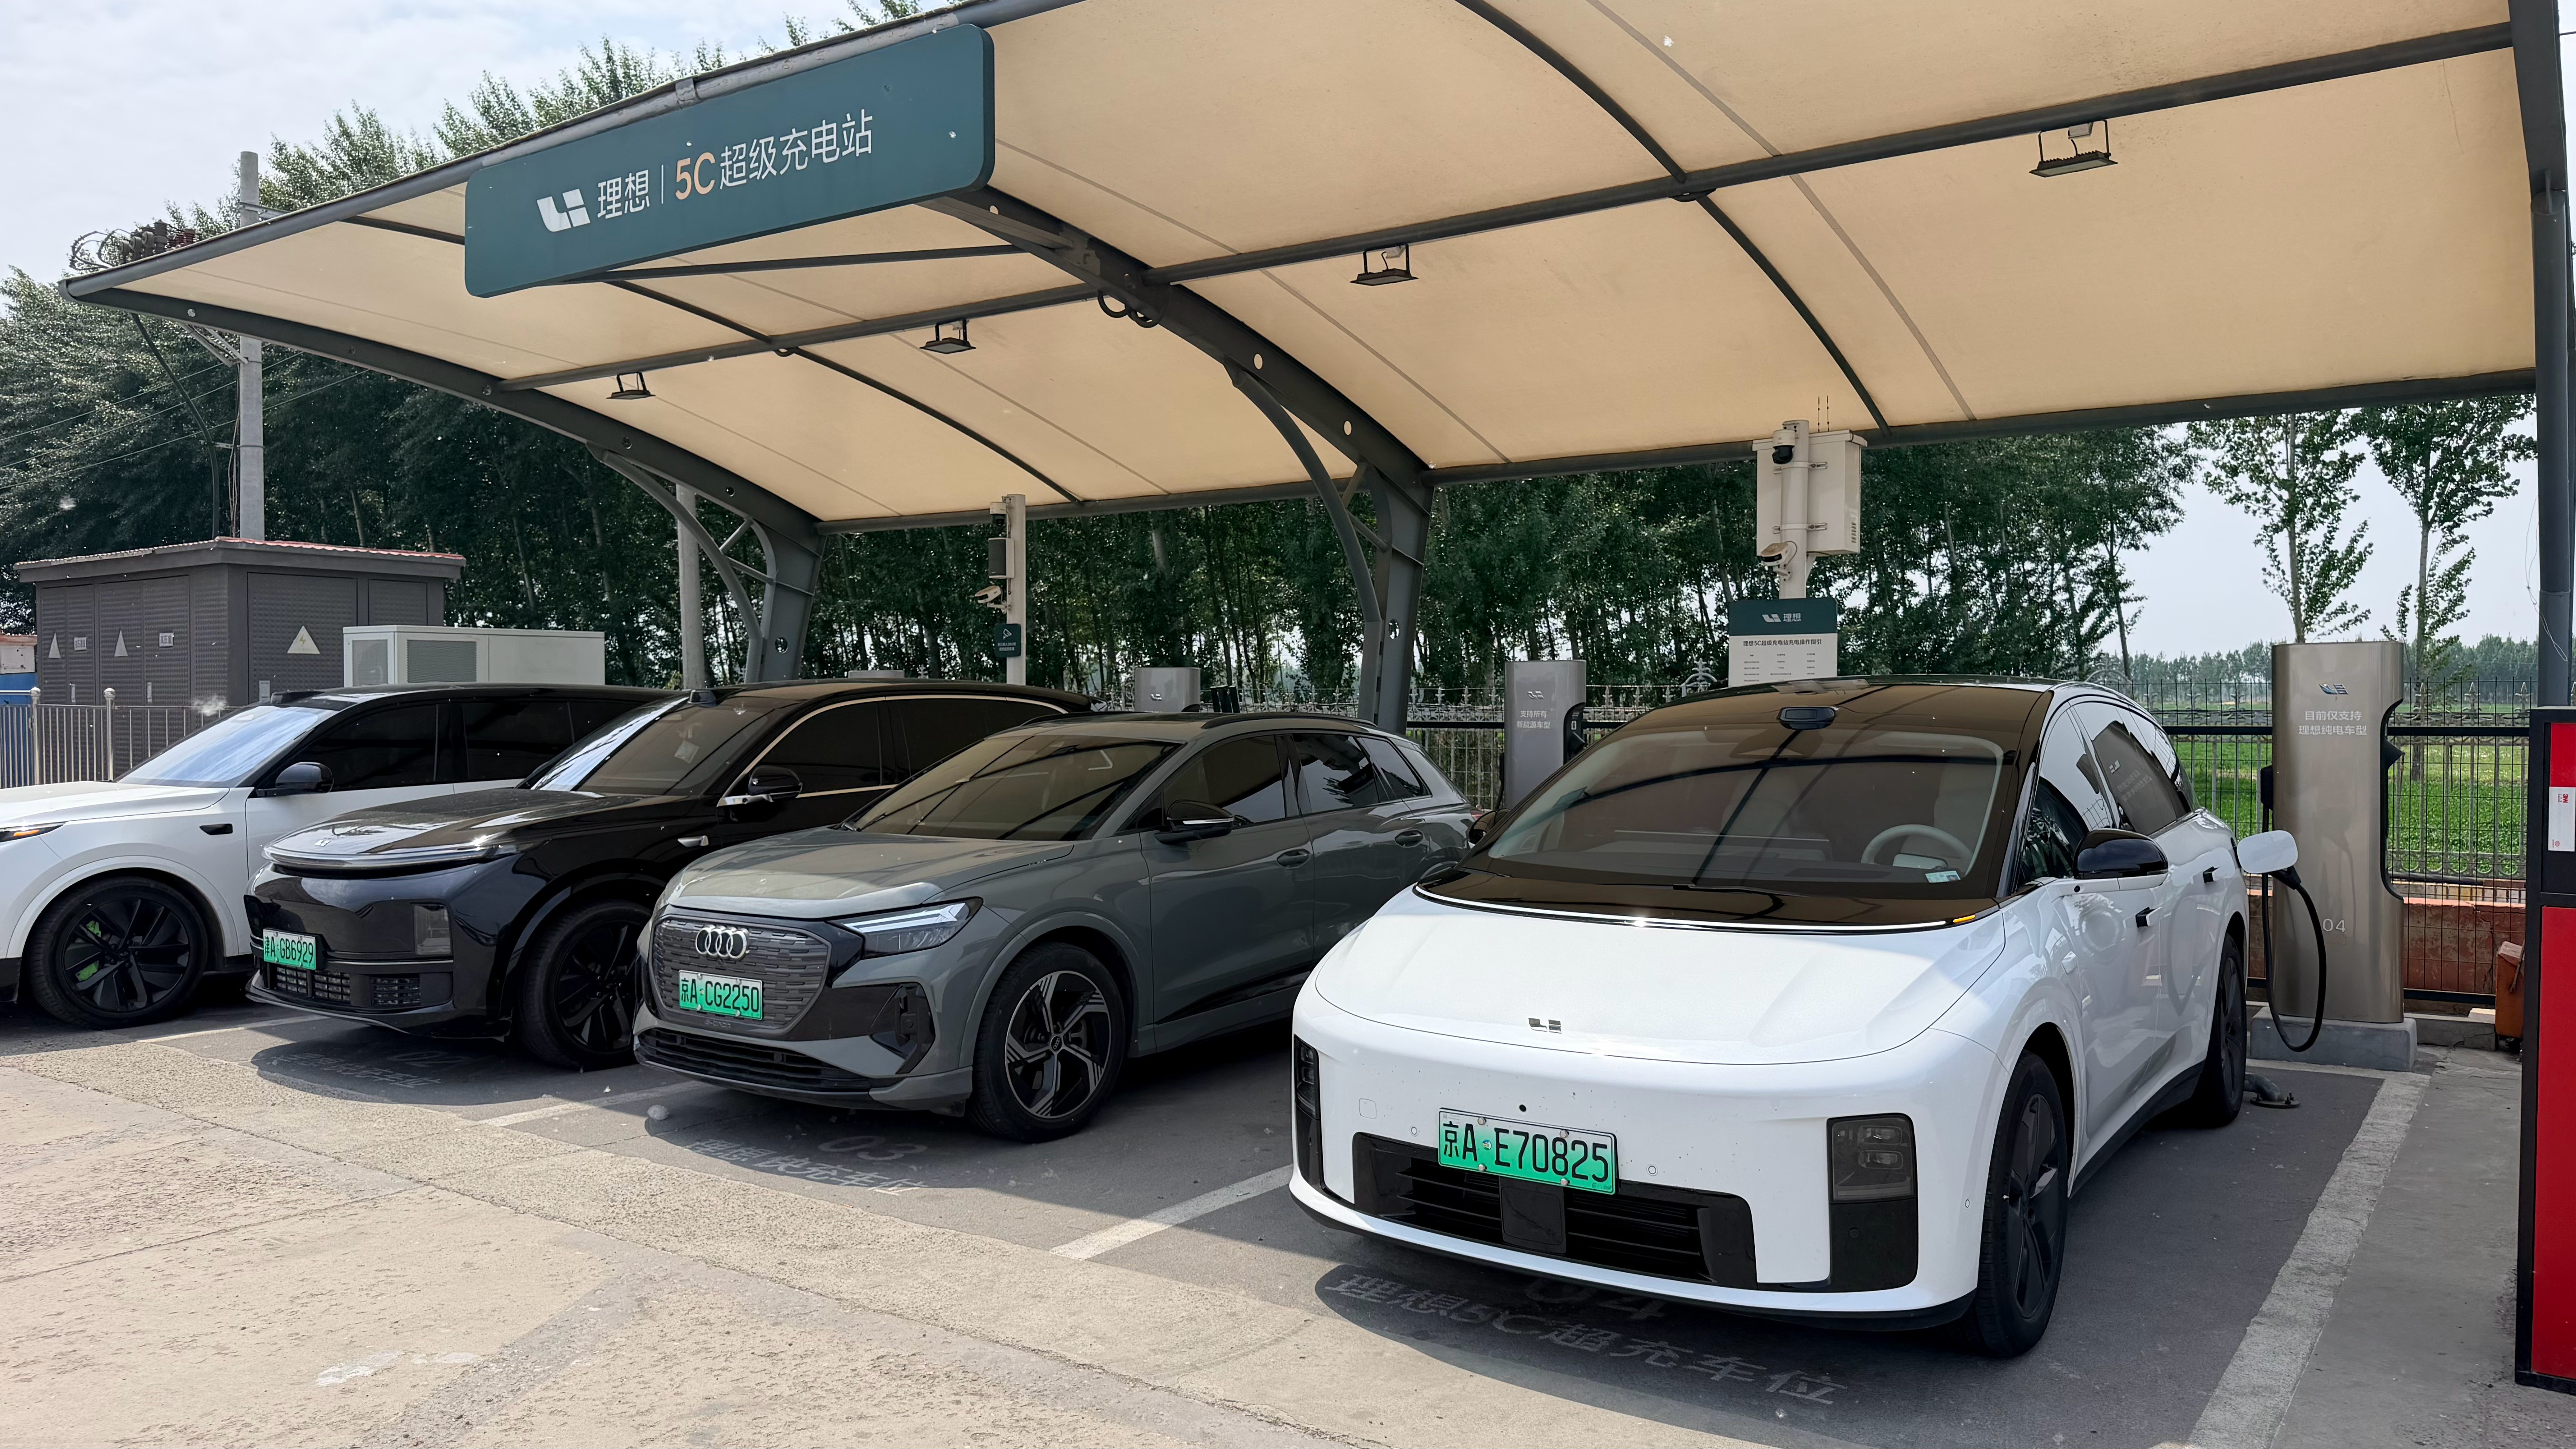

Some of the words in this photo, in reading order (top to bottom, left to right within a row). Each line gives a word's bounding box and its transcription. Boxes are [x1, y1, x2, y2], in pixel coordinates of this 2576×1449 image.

[597, 169, 650, 220] 理想
[675, 109, 873, 201] 5C超级充电站
[1783, 612, 1802, 622] 理想
[2305, 711, 2362, 721] 目前仅支持
[1516, 720, 1550, 729] 新能源车型
[2298, 725, 2367, 735] 理想纯电车型
[2322, 918, 2346, 933] 04
[818, 1135, 928, 1160] 03
[1324, 1273, 1847, 1405] 理想5C超充车位
